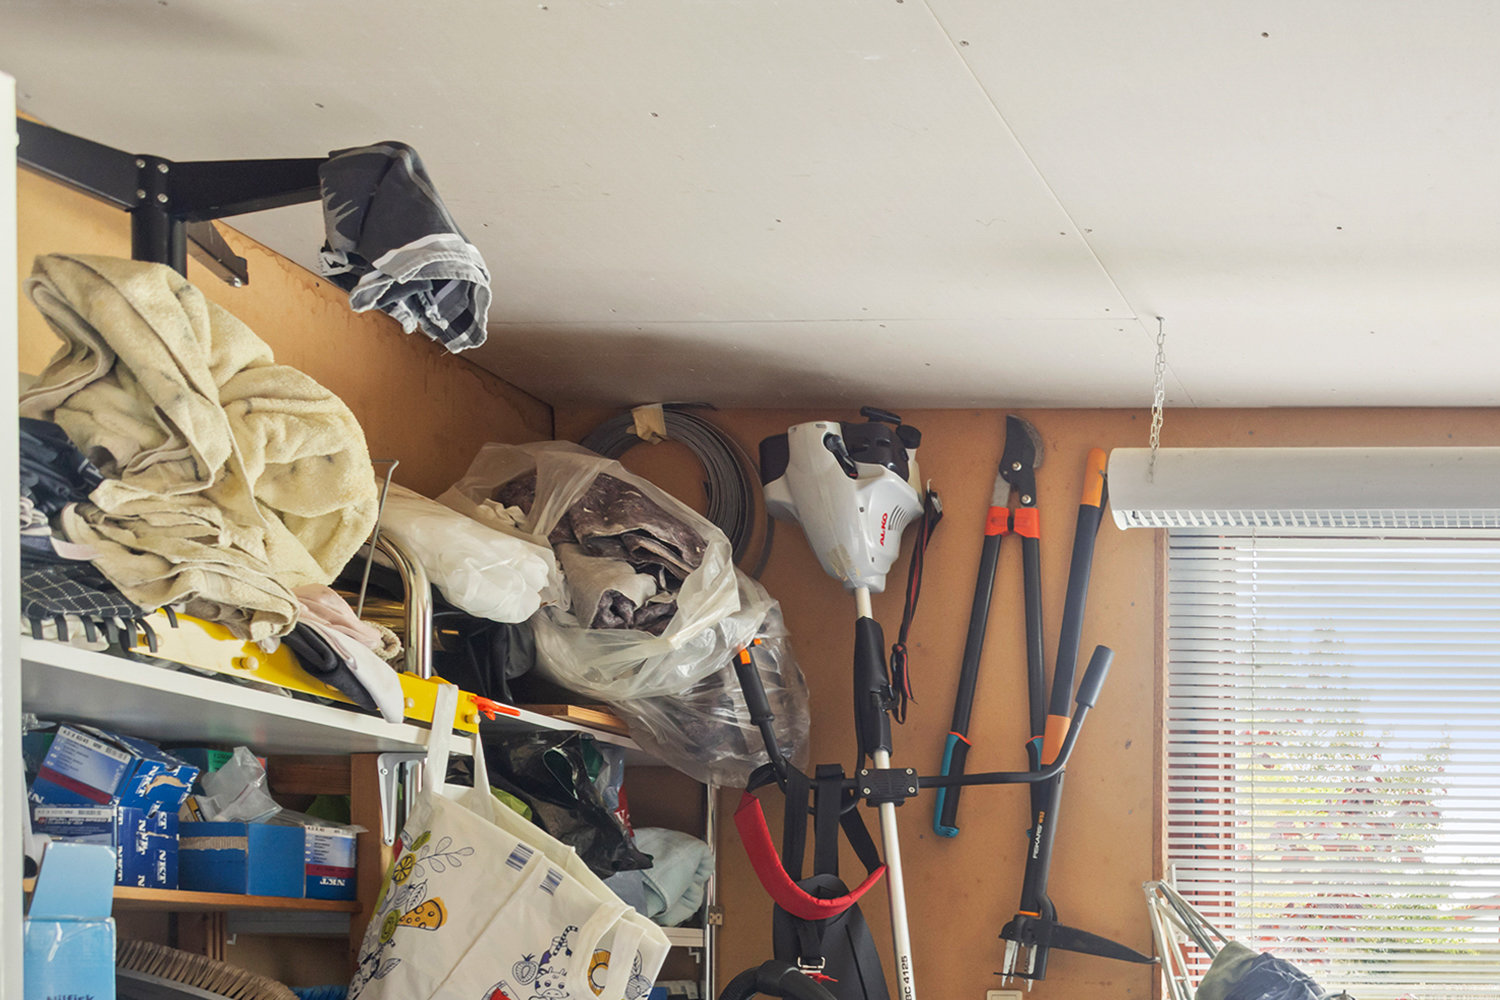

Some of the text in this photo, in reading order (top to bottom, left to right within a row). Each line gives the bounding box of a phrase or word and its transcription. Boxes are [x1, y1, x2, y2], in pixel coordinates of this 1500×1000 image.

[157, 849, 167, 884] NKT
[319, 876, 346, 887] NKT
[901, 955, 910, 984] 4125
